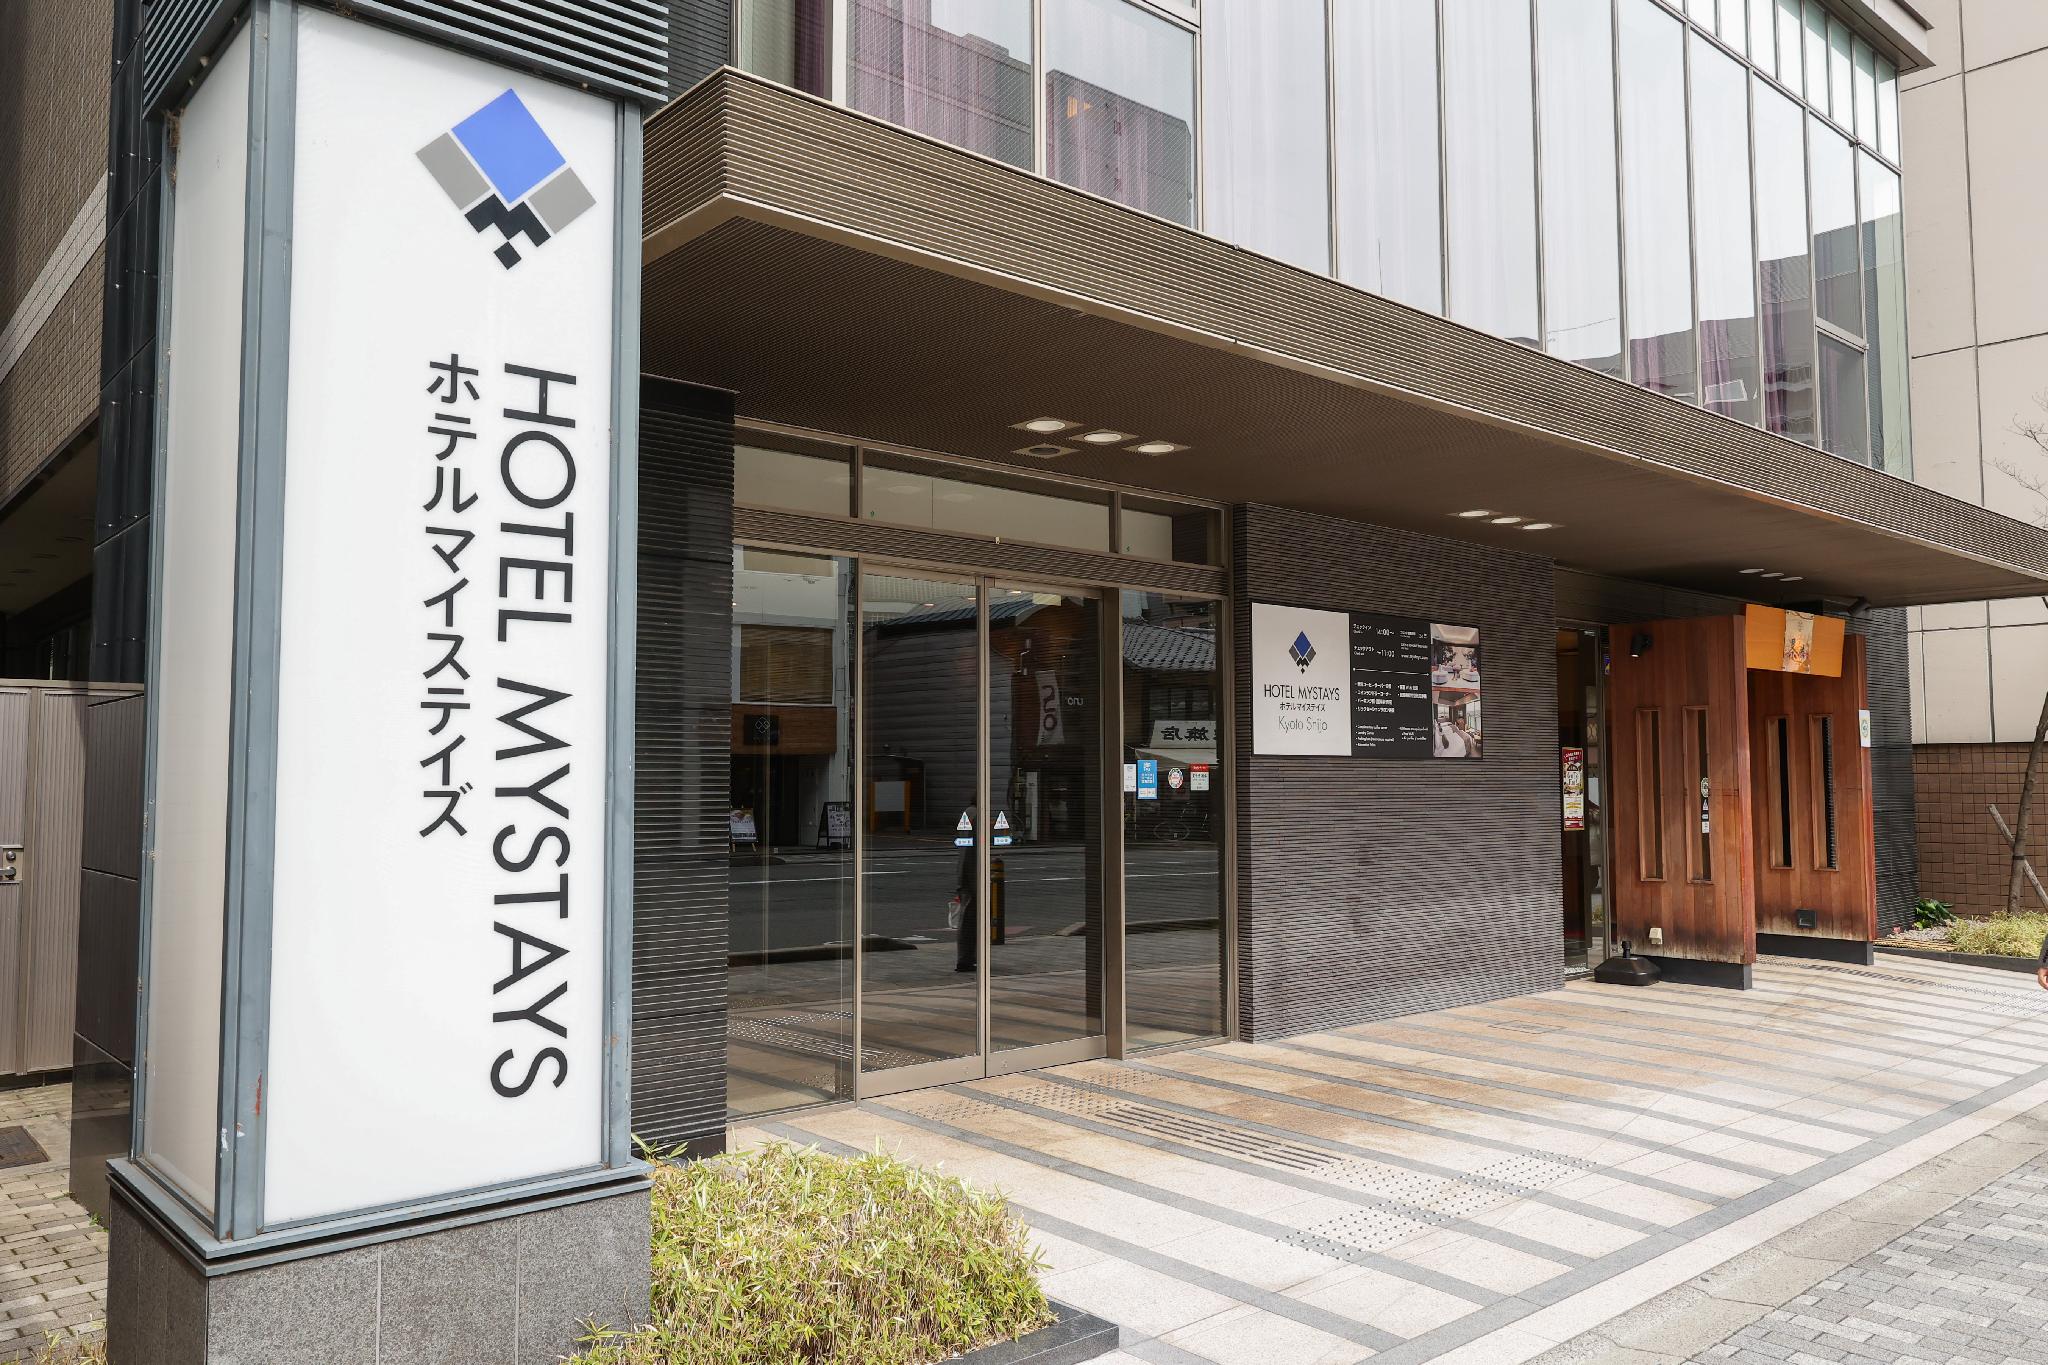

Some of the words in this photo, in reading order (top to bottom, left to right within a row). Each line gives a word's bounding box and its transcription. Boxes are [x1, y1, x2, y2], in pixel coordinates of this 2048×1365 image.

[498, 362, 576, 642] HOTEL
[419, 353, 480, 838] ホテルマイステイズ
[1264, 684, 1295, 699] HOTEL
[1298, 686, 1340, 701] MYSTAYS
[1278, 715, 1304, 734] Kyoto
[1279, 702, 1326, 712] ホテルマイステイズ
[490, 677, 573, 1098] MYSTAYS
